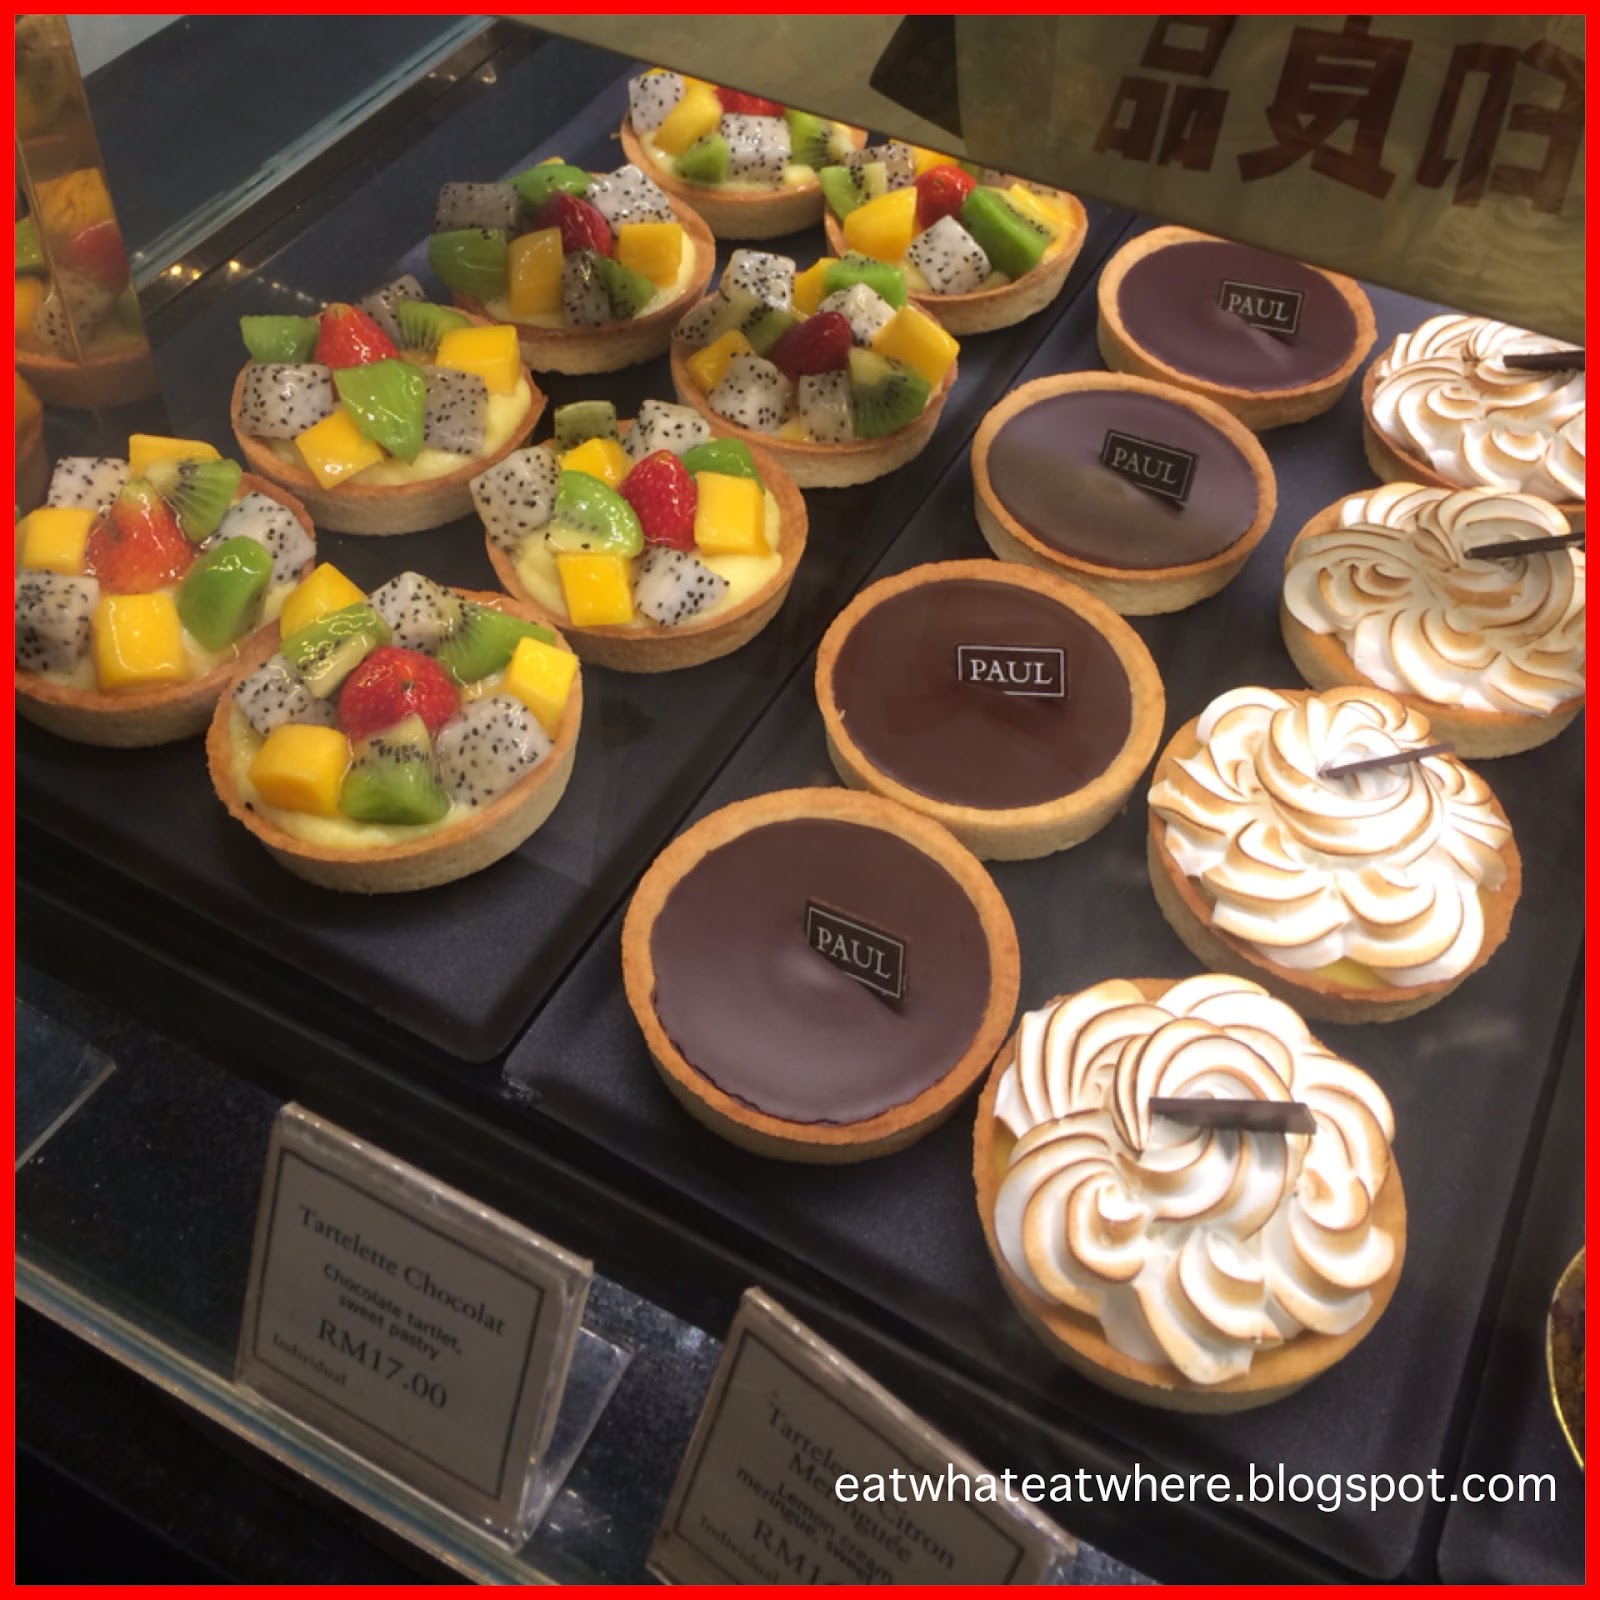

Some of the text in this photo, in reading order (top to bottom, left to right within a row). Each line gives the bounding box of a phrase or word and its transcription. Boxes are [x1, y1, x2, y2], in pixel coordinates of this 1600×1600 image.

[1228, 293, 1290, 322] PAUL
[1111, 447, 1177, 485] PAUL
[969, 659, 1053, 685] PAUL
[816, 926, 892, 979] PAUL
[298, 1203, 506, 1337] Tartelette Chocolat
[323, 1262, 463, 1356] Chocolate tartlet,
[338, 1293, 440, 1362] sweet pastry
[272, 1333, 347, 1387] Individual
[317, 1317, 448, 1409] RM17.00
[754, 1517, 846, 1585] RM1
